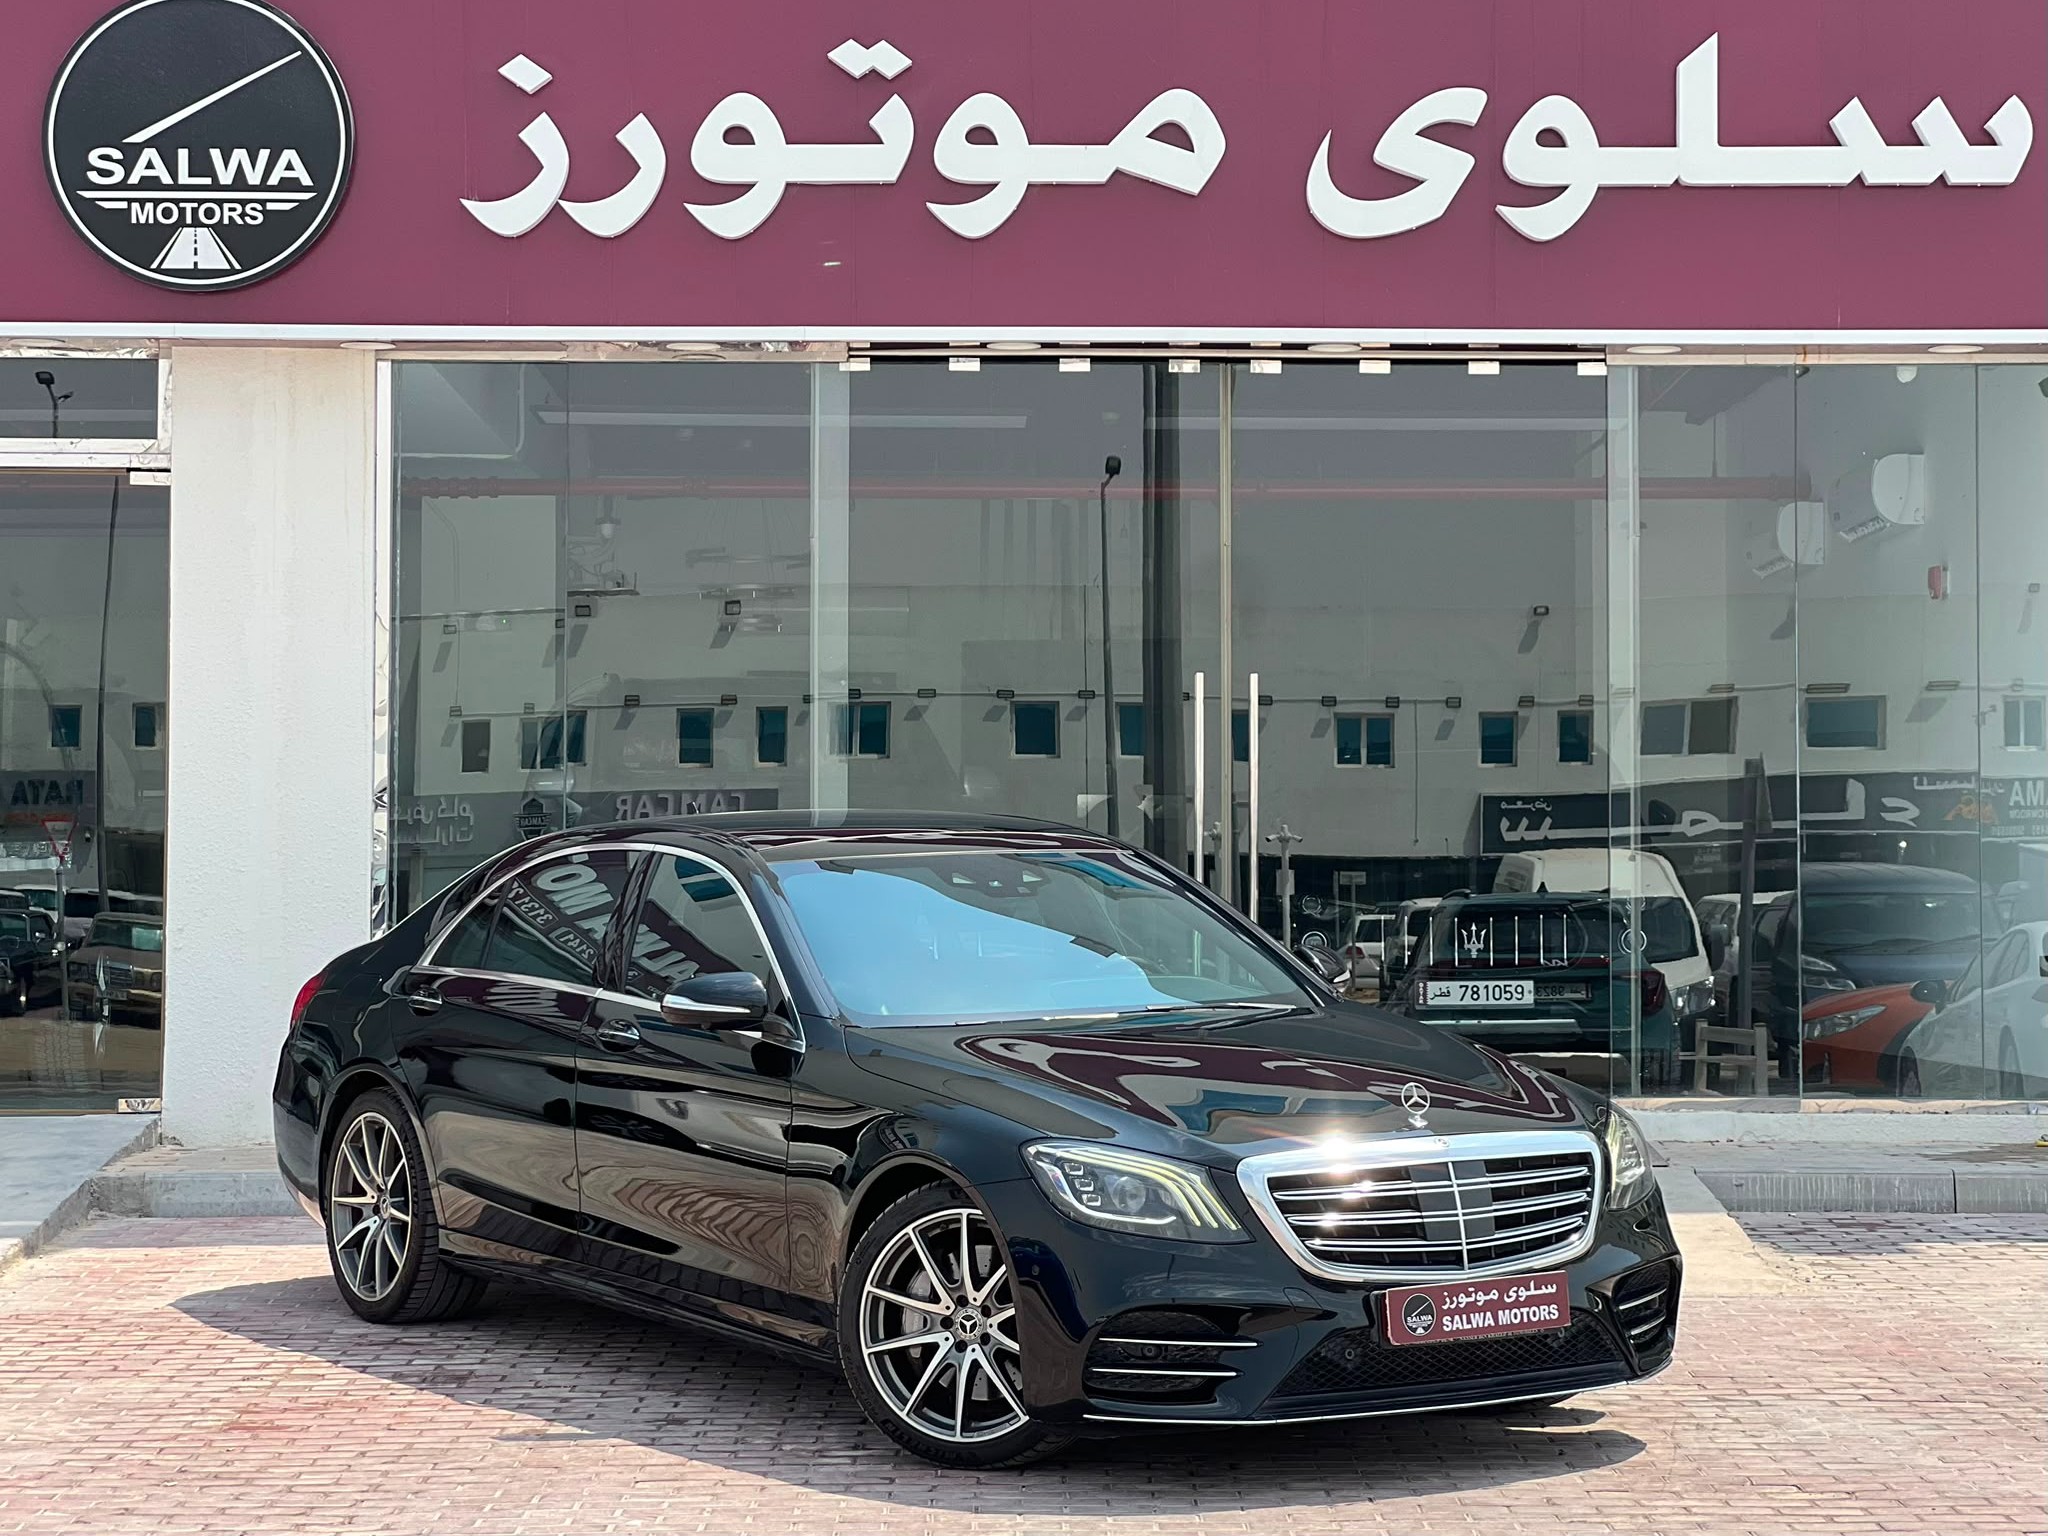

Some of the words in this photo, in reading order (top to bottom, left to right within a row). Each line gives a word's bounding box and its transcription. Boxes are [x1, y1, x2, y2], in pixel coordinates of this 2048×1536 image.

[459, 38, 1227, 240] موتورز
[1306, 32, 2034, 242] سلوى
[86, 146, 314, 187] SALWA
[130, 201, 265, 226] MOTORS
[1430, 986, 1451, 1000] قطر
[1458, 984, 1525, 1002] 781059
[1441, 1287, 1499, 1310] موتورز
[1503, 1280, 1557, 1303] سلوى
[1406, 1314, 1433, 1323] SALWA
[1442, 1310, 1495, 1332] SALWA
[1498, 1304, 1559, 1325] MOTORS
